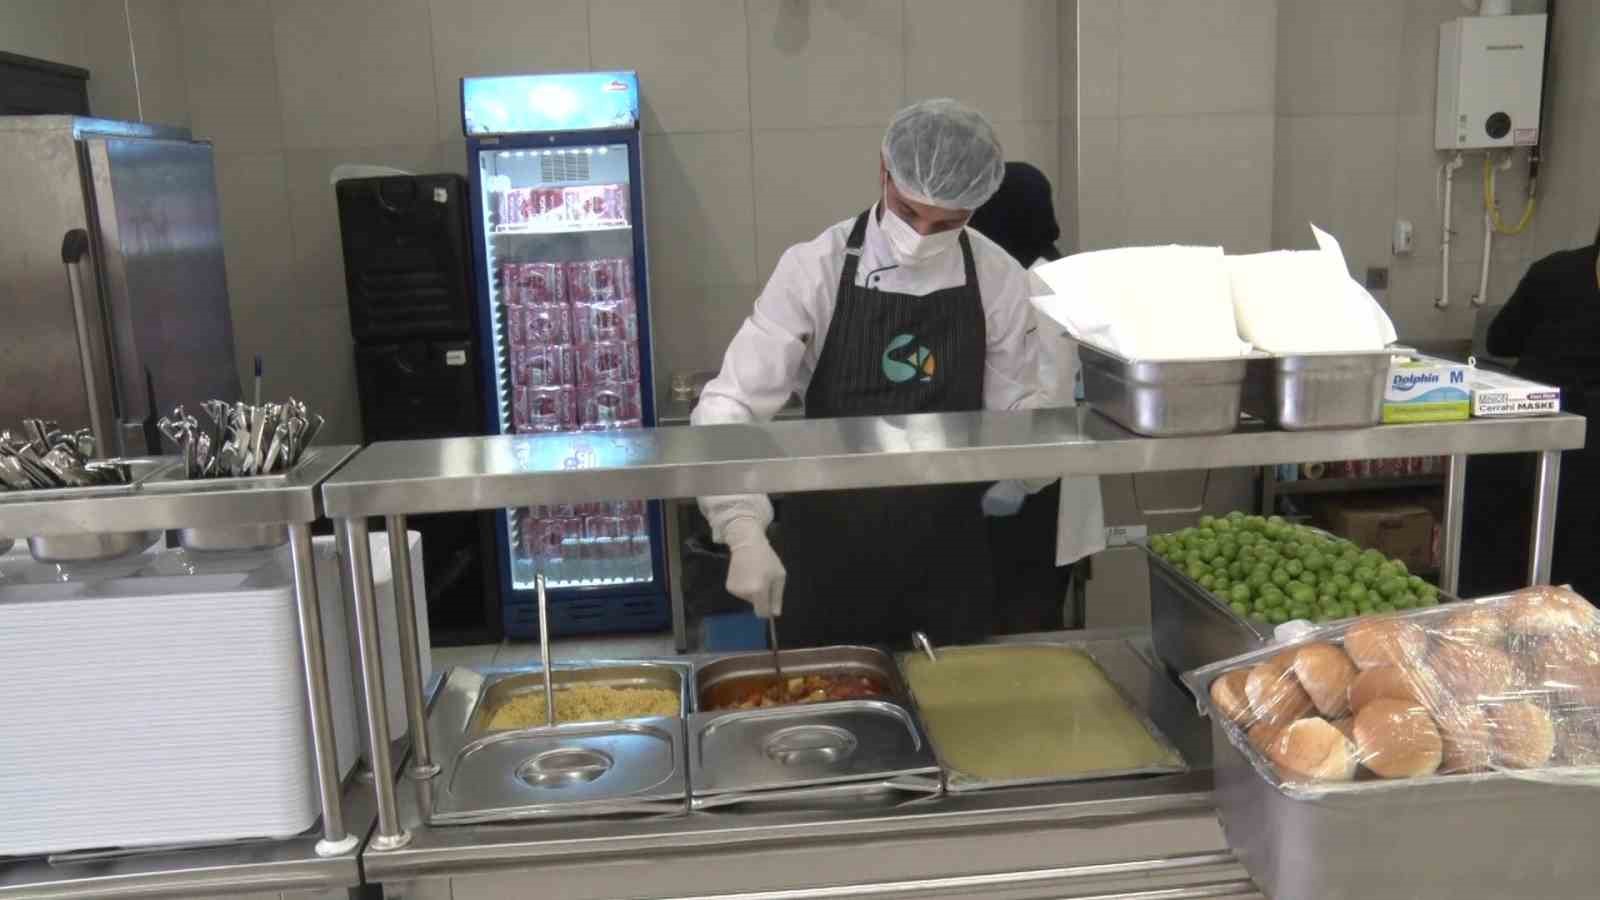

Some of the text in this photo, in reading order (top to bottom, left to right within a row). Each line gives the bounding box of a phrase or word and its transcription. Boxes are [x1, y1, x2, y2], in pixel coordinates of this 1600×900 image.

[1392, 373, 1439, 385] Dolphin
[1450, 371, 1464, 383] M
[1517, 402, 1555, 410] MASKE
